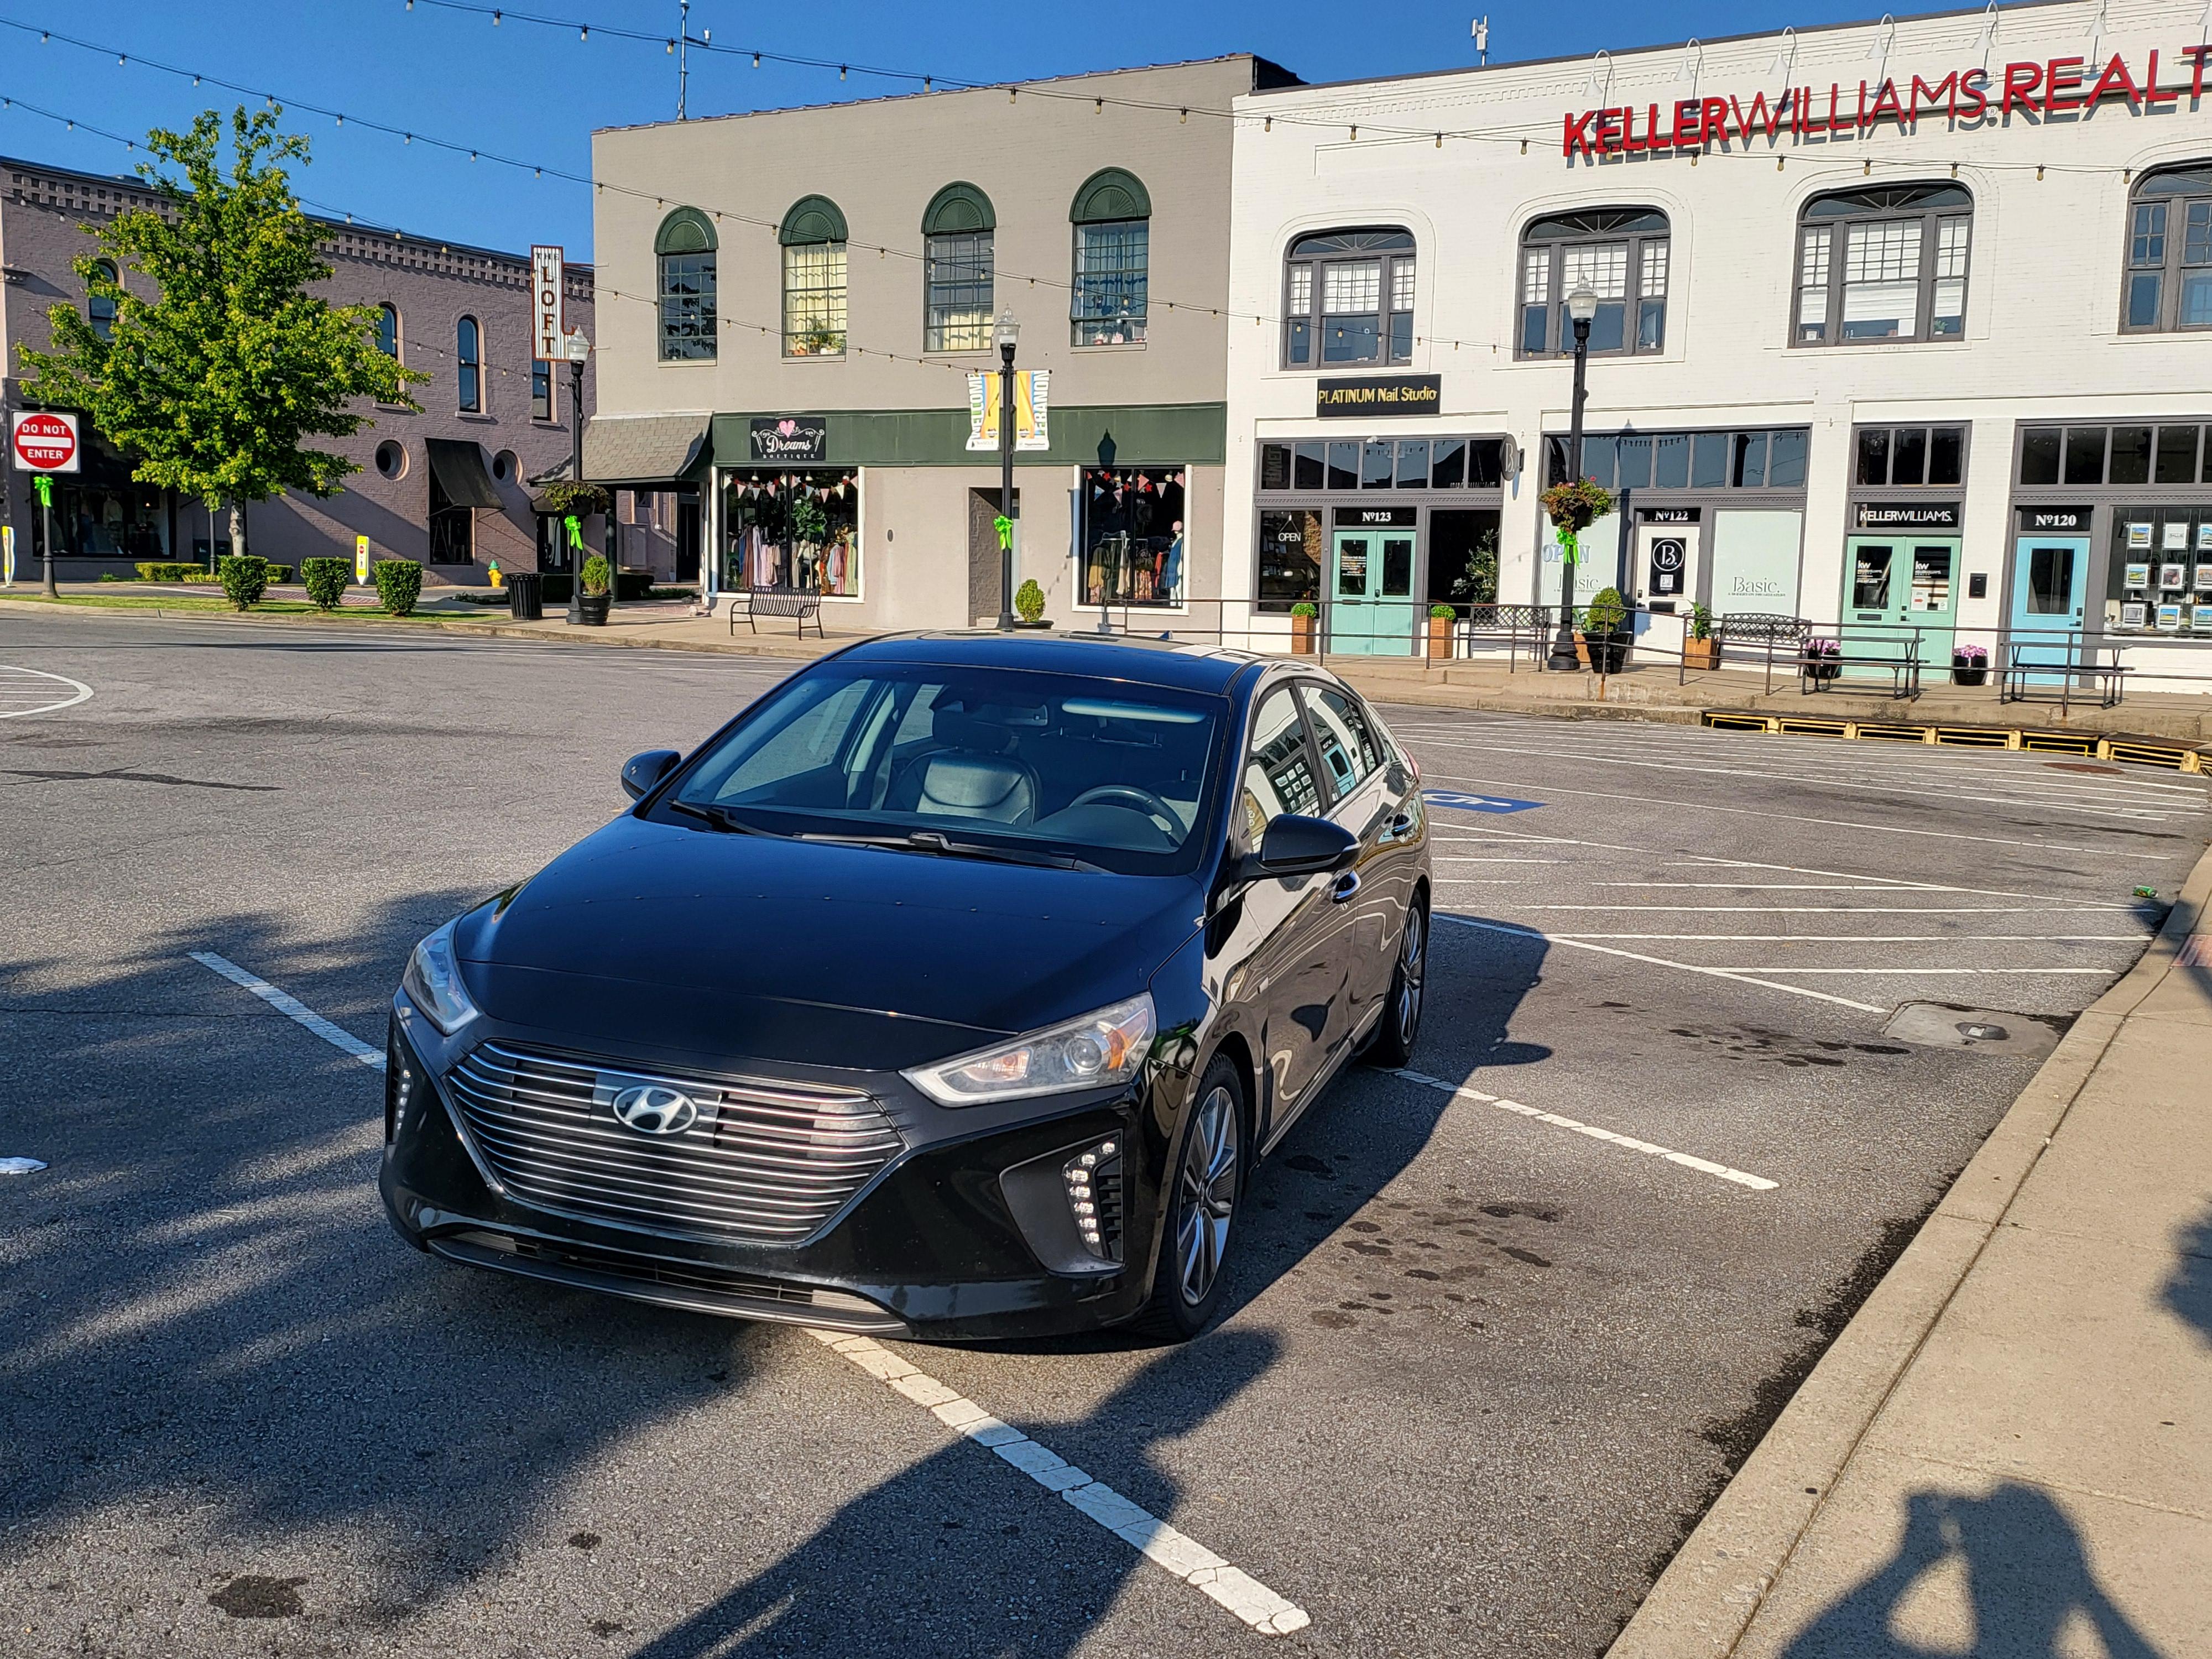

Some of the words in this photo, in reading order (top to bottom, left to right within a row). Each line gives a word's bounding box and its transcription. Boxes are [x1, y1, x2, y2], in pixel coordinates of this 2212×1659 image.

[541, 266, 555, 353] LOFT
[1318, 388, 1376, 404] PLATINUM
[1378, 387, 1400, 403] Nail
[1401, 385, 1438, 401] Studio
[1033, 370, 1050, 438] LEBANON
[22, 424, 38, 433] DO
[43, 425, 66, 435] NOT
[766, 435, 812, 453] Dreams
[27, 448, 64, 460] ENTER
[1278, 533, 1301, 541] OPEN
[1543, 545, 1591, 563] OPN
[1858, 560, 1871, 569] kw
[1915, 561, 1929, 570] kw
